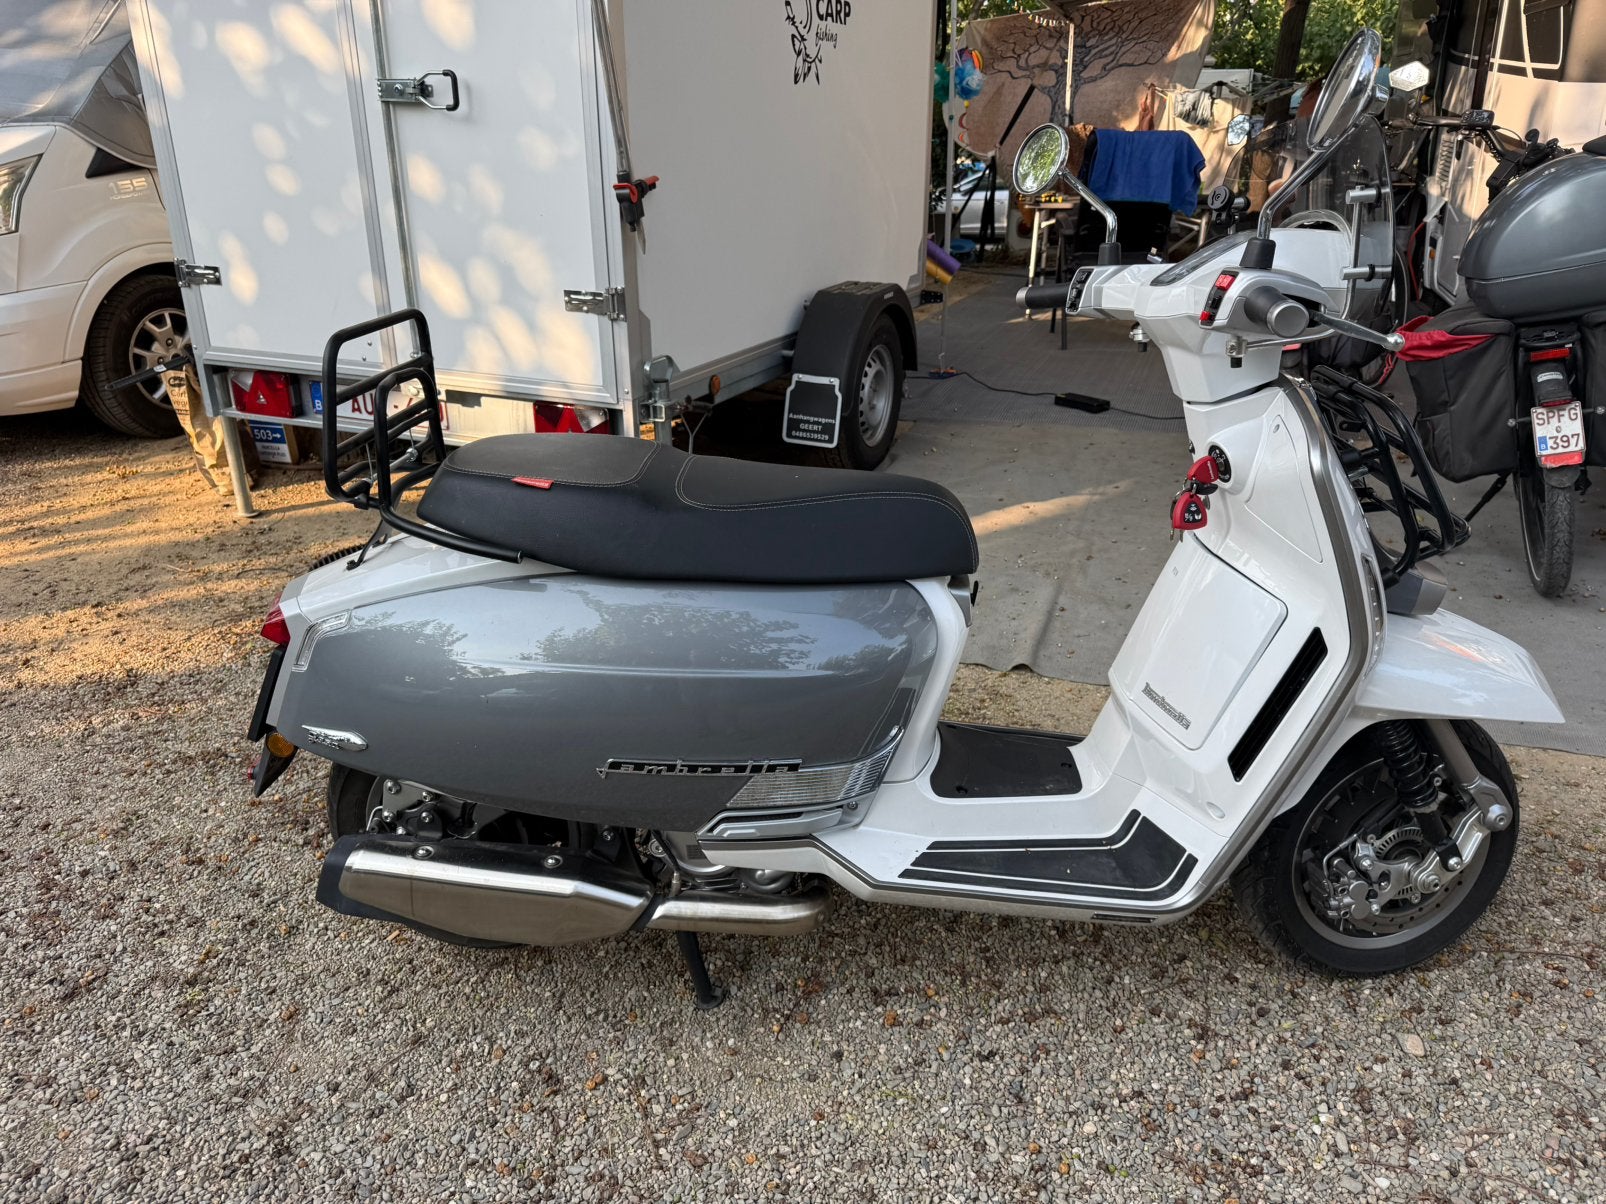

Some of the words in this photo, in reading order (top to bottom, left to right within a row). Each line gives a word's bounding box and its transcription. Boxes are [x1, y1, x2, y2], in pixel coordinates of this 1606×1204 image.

[815, 0, 852, 25] CARP
[815, 23, 838, 49] fishing
[108, 177, 148, 194] 155
[314, 400, 323, 411] B
[1535, 406, 1579, 427] SPFG
[253, 429, 274, 441] 503
[799, 423, 823, 431] GEERT
[1548, 432, 1580, 451] 397
